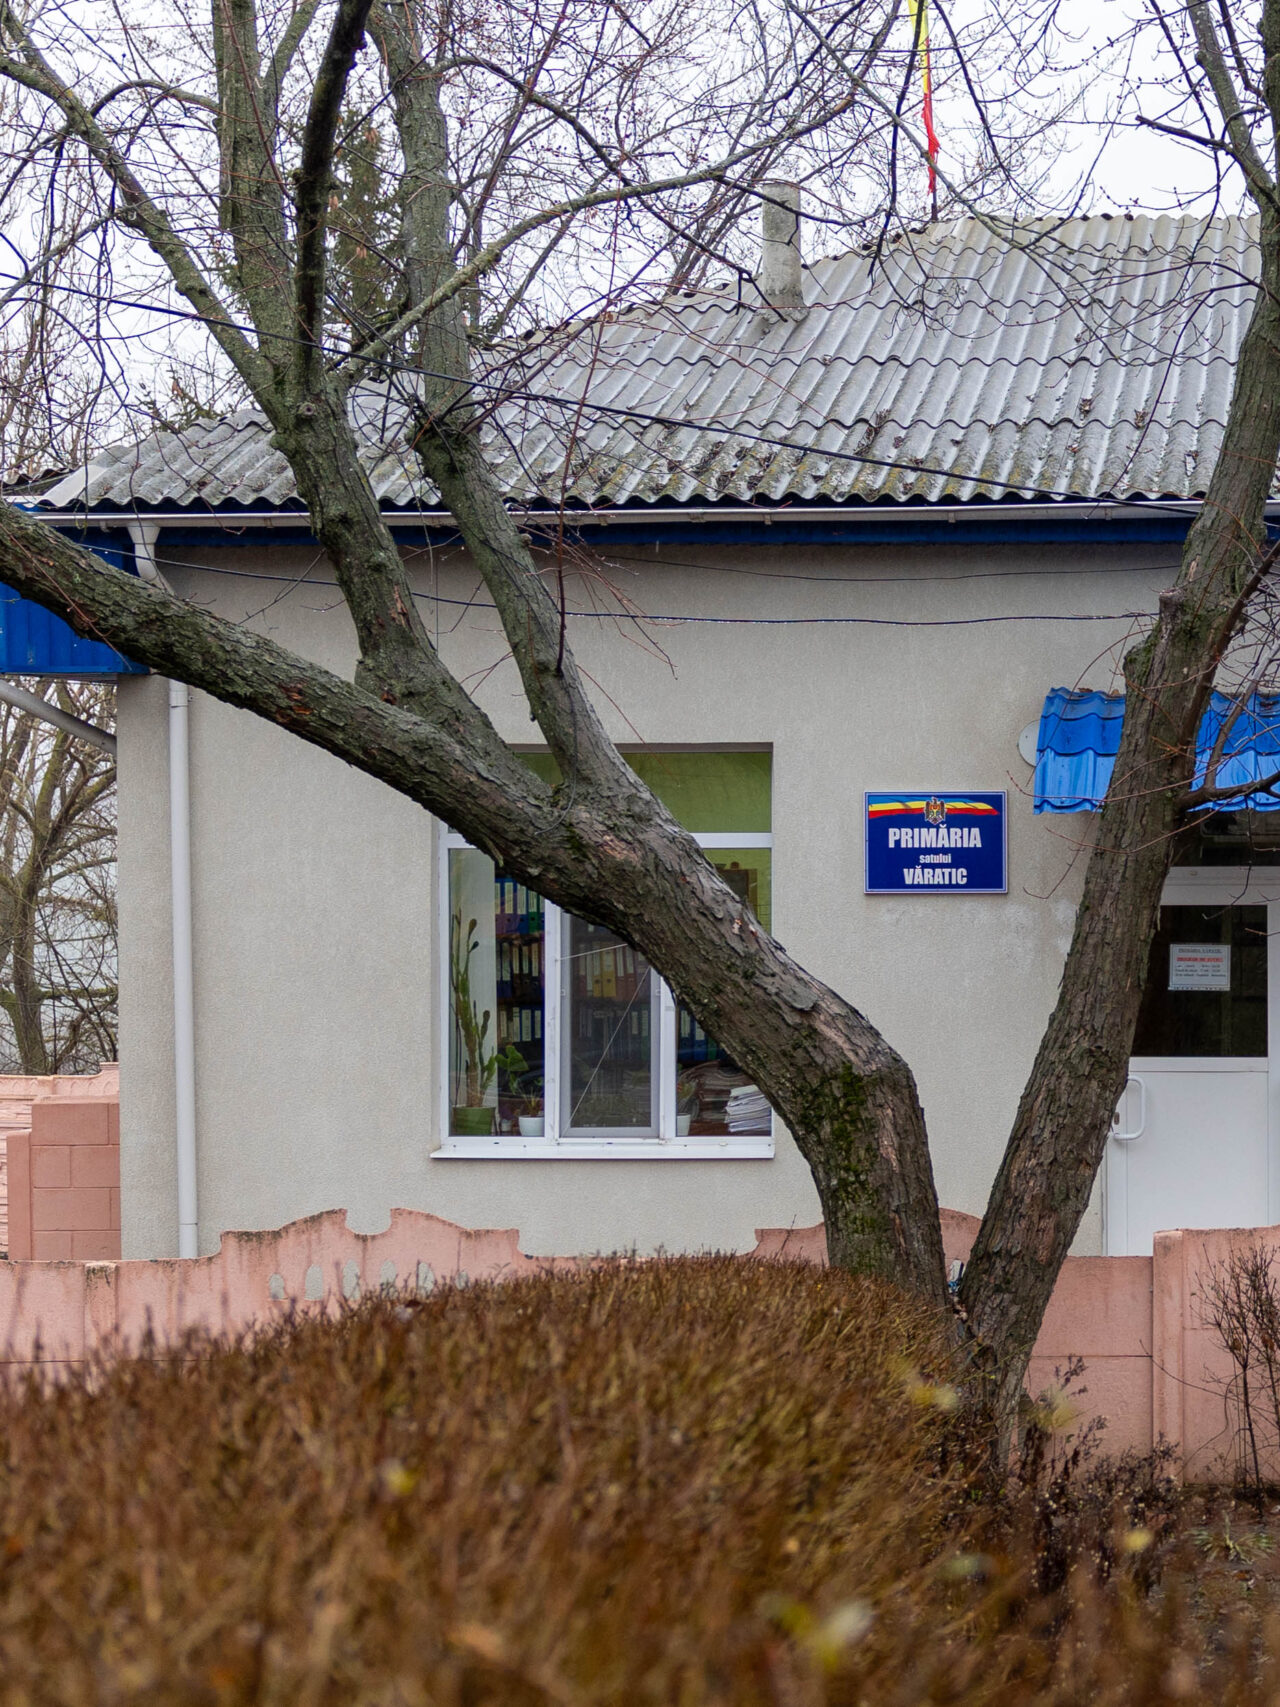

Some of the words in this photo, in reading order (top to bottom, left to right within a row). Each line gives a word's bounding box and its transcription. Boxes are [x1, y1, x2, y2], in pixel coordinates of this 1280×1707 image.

[888, 824, 982, 848] PRIMĂRIA
[919, 853, 952, 864] satului
[903, 865, 968, 885] VĂRATIC
